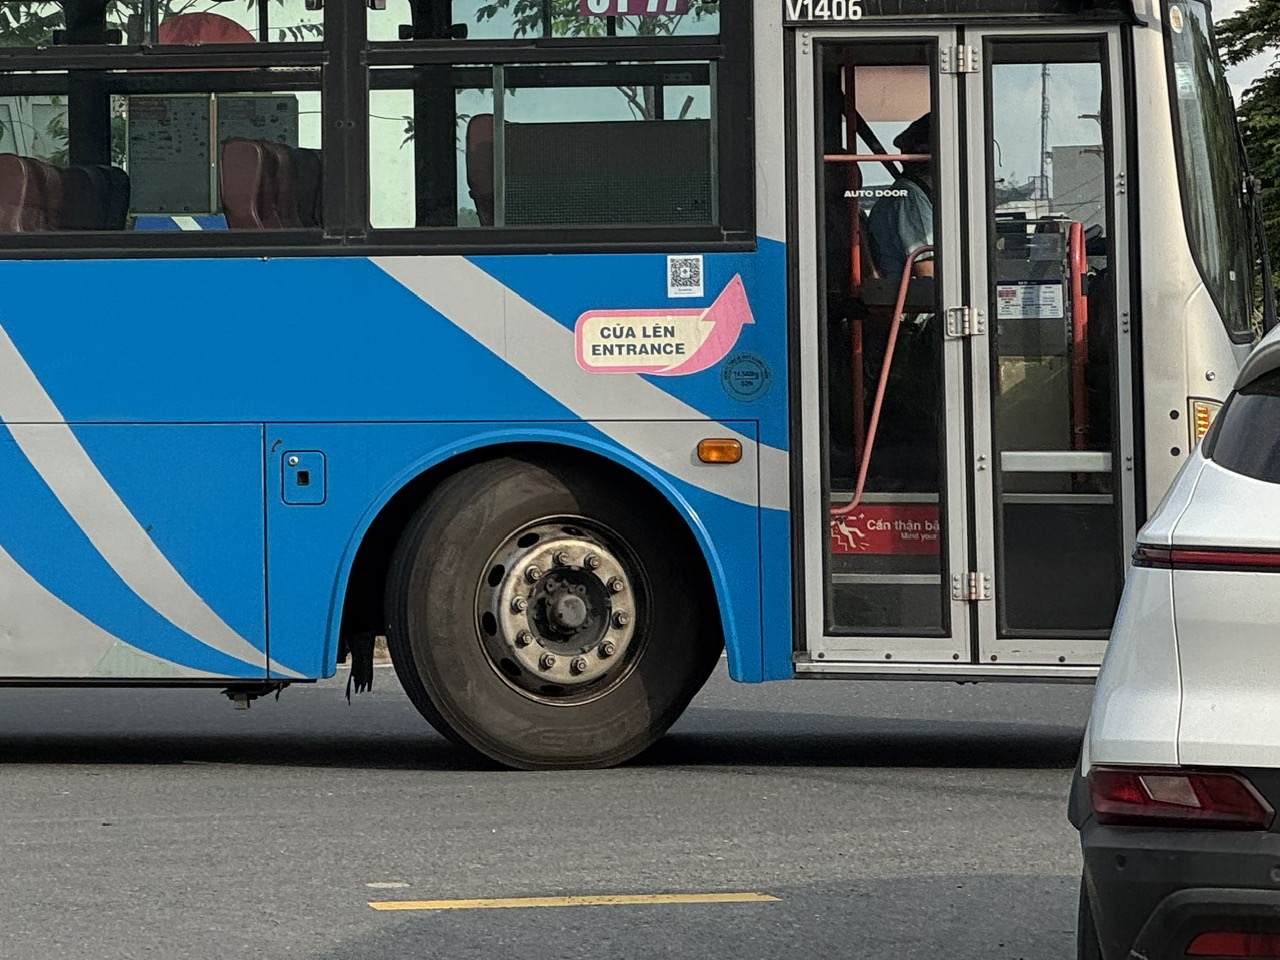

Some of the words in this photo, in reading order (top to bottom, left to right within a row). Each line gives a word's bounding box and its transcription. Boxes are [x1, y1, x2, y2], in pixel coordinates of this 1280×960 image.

[875, 189, 908, 197] DOOR
[600, 323, 636, 339] CỬA
[642, 323, 675, 338] LÊN
[591, 343, 685, 356] ENTRANCE
